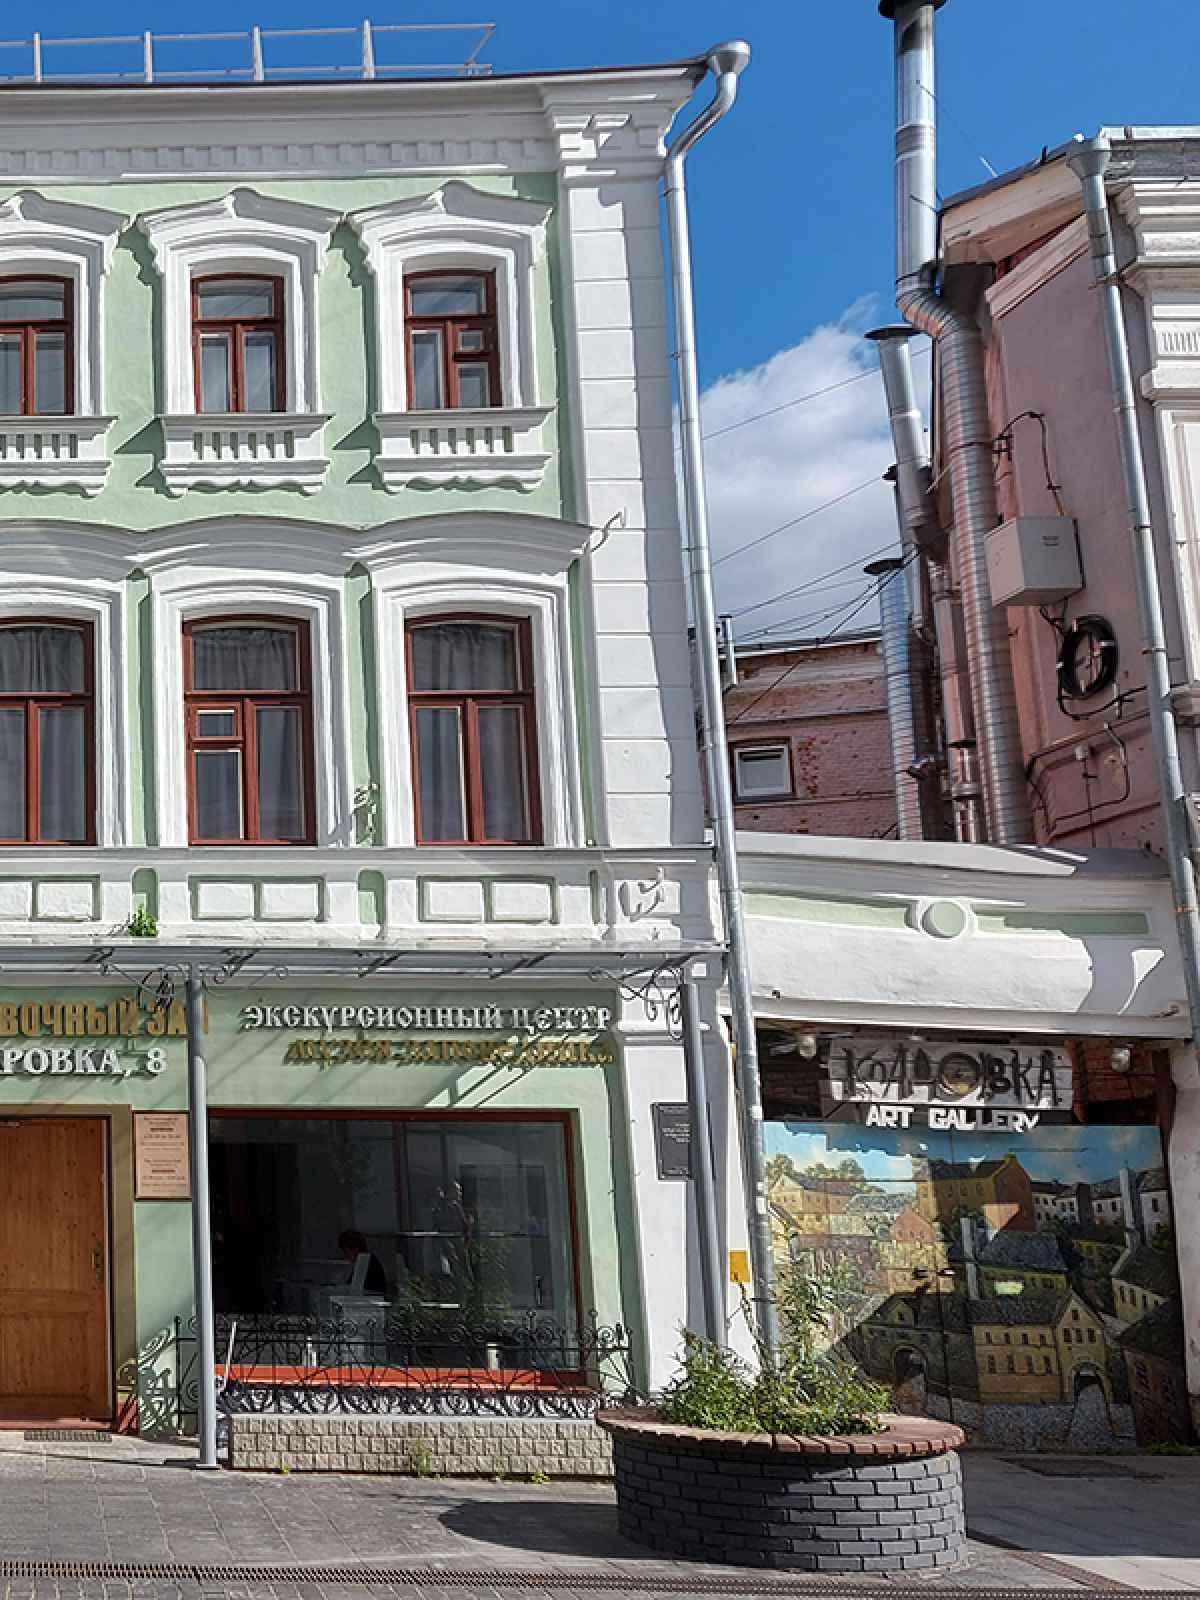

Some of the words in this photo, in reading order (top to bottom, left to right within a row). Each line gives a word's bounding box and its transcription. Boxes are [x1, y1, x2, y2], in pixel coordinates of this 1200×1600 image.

[146, 999, 209, 1036] ЗА
[245, 1002, 502, 1031] ЭКСКУРСИОННЫЙ
[510, 1005, 612, 1034] ЦЕНТР
[146, 1049, 168, 1074] 8
[866, 1104, 914, 1130] ART
[927, 1108, 1040, 1133] GALLERY
